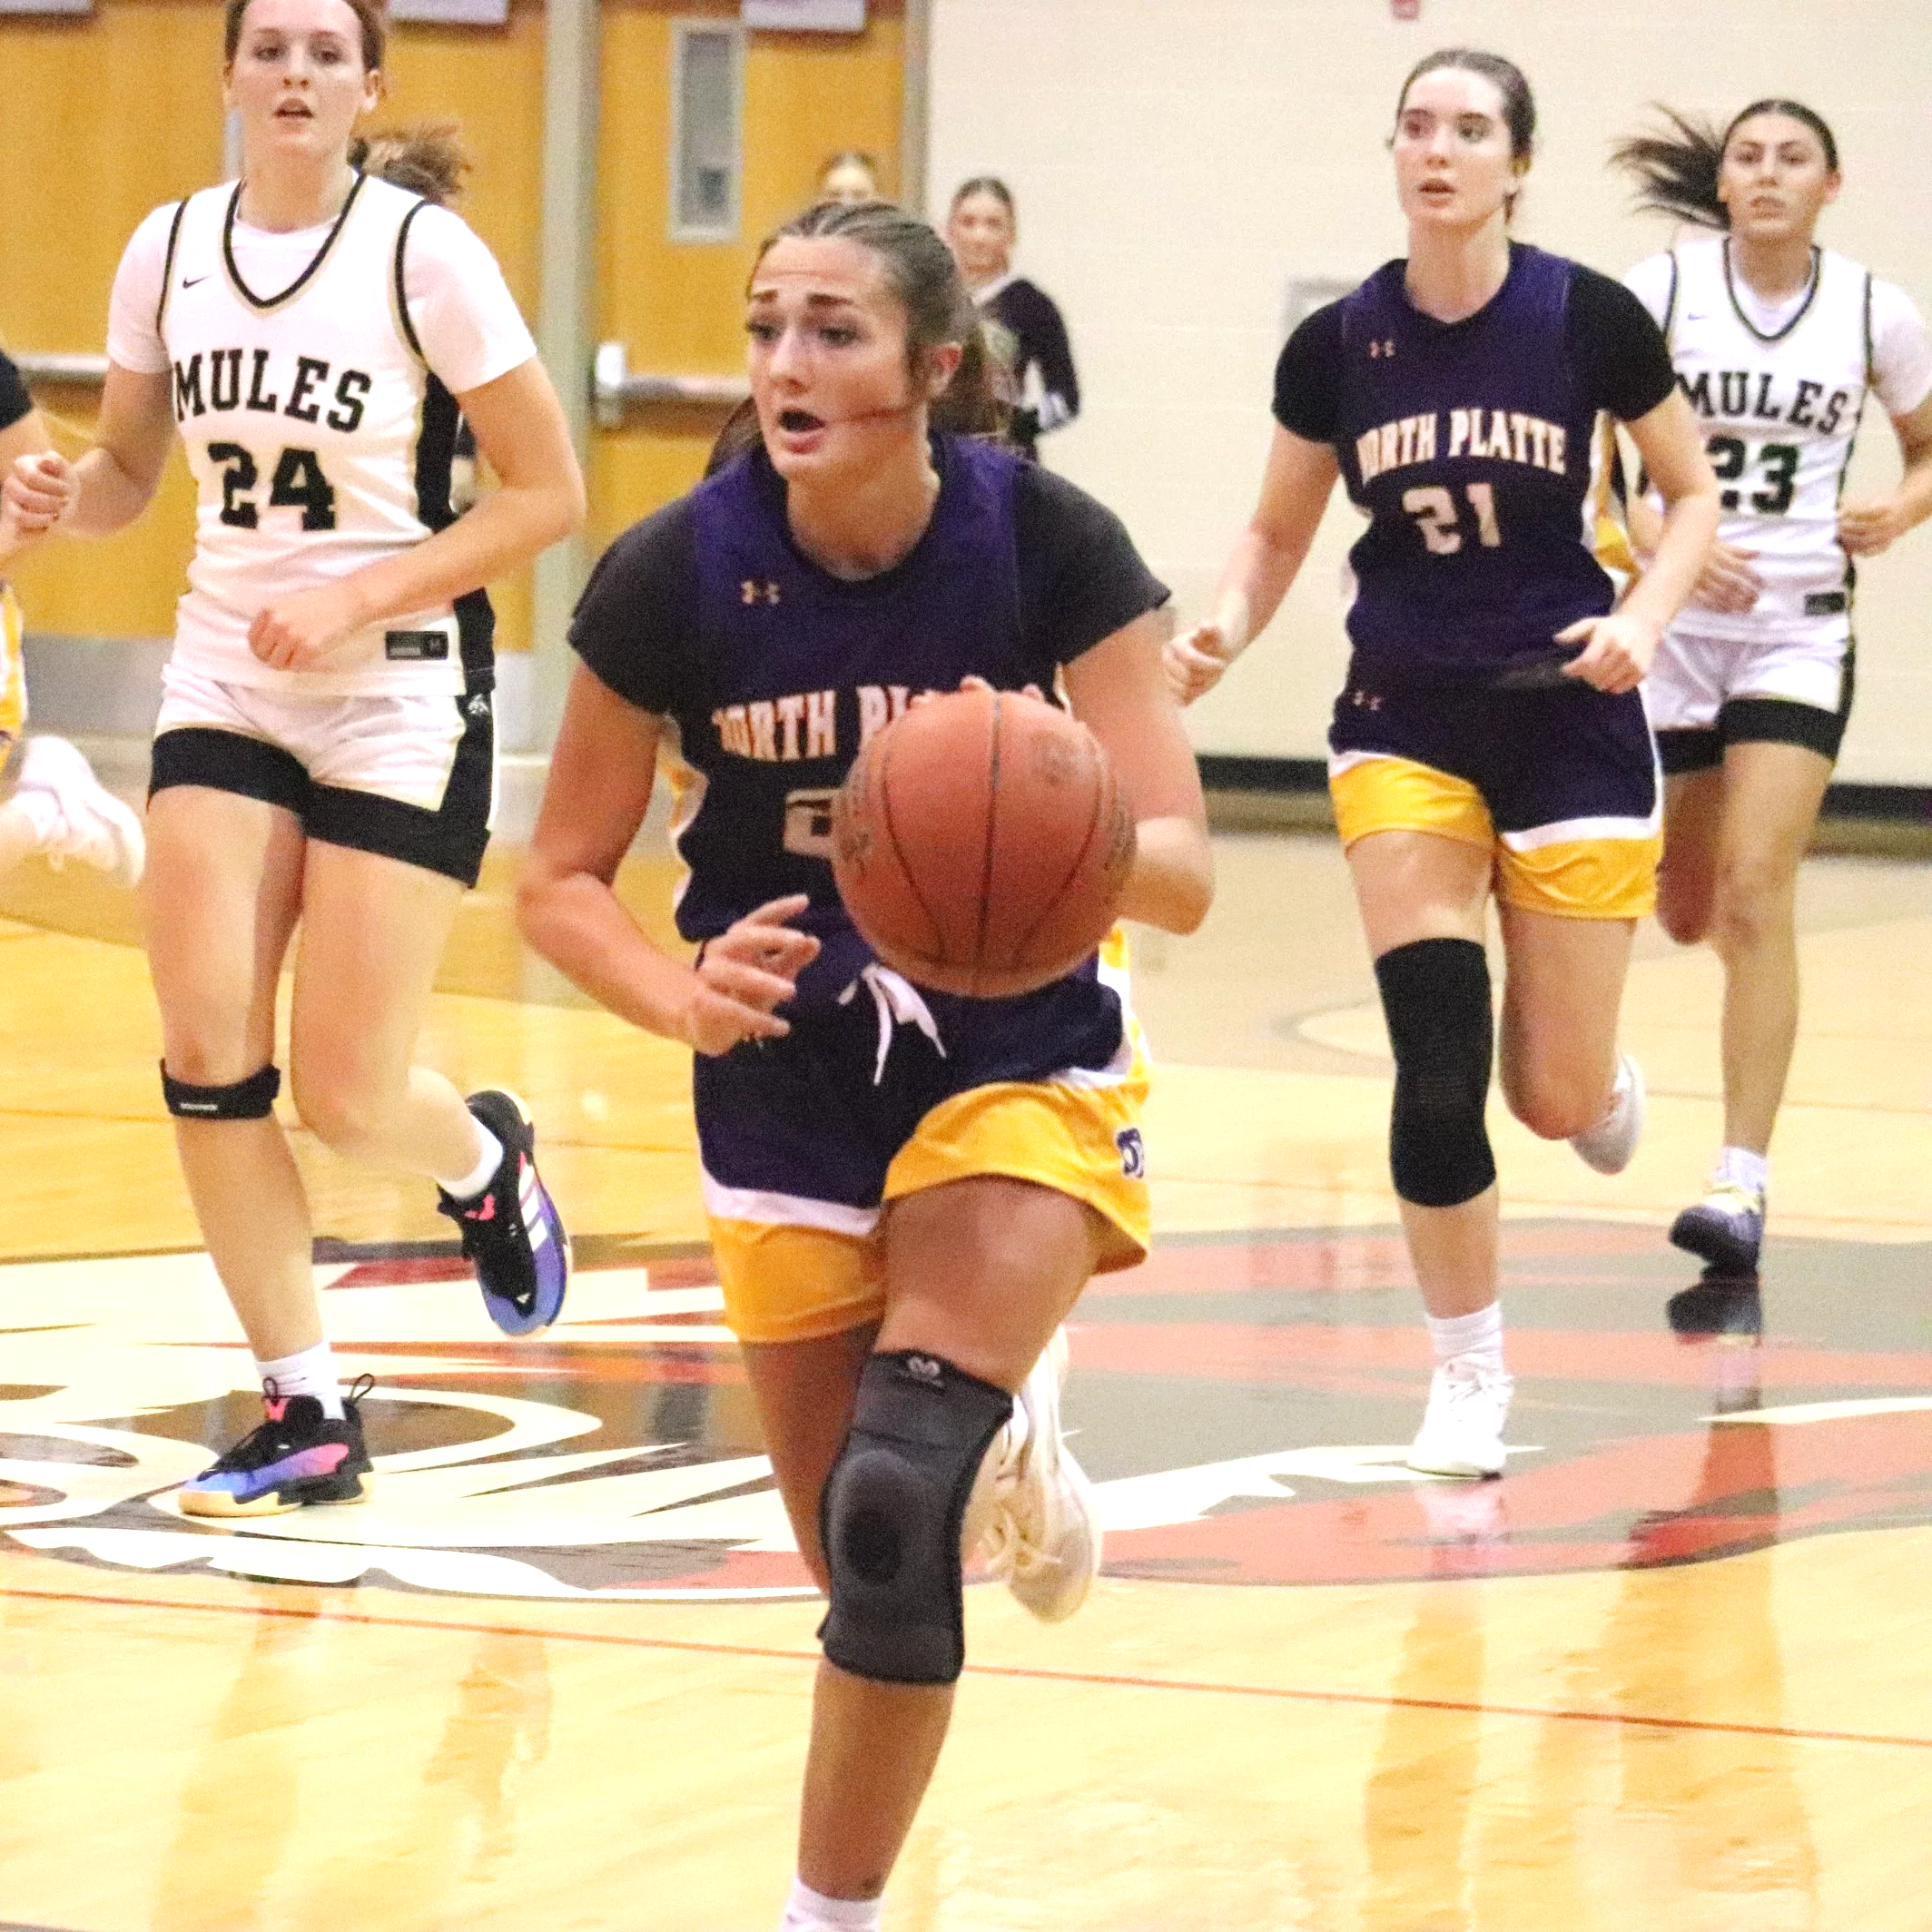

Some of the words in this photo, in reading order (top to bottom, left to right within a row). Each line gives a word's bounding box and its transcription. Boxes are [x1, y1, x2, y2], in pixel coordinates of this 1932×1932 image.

[174, 349, 372, 433] MULES
[1675, 370, 1848, 435] MULES
[1447, 407, 1565, 475] PLATTE
[1706, 434, 1799, 514] 23
[207, 441, 336, 531] 24
[1401, 482, 1501, 555] 21
